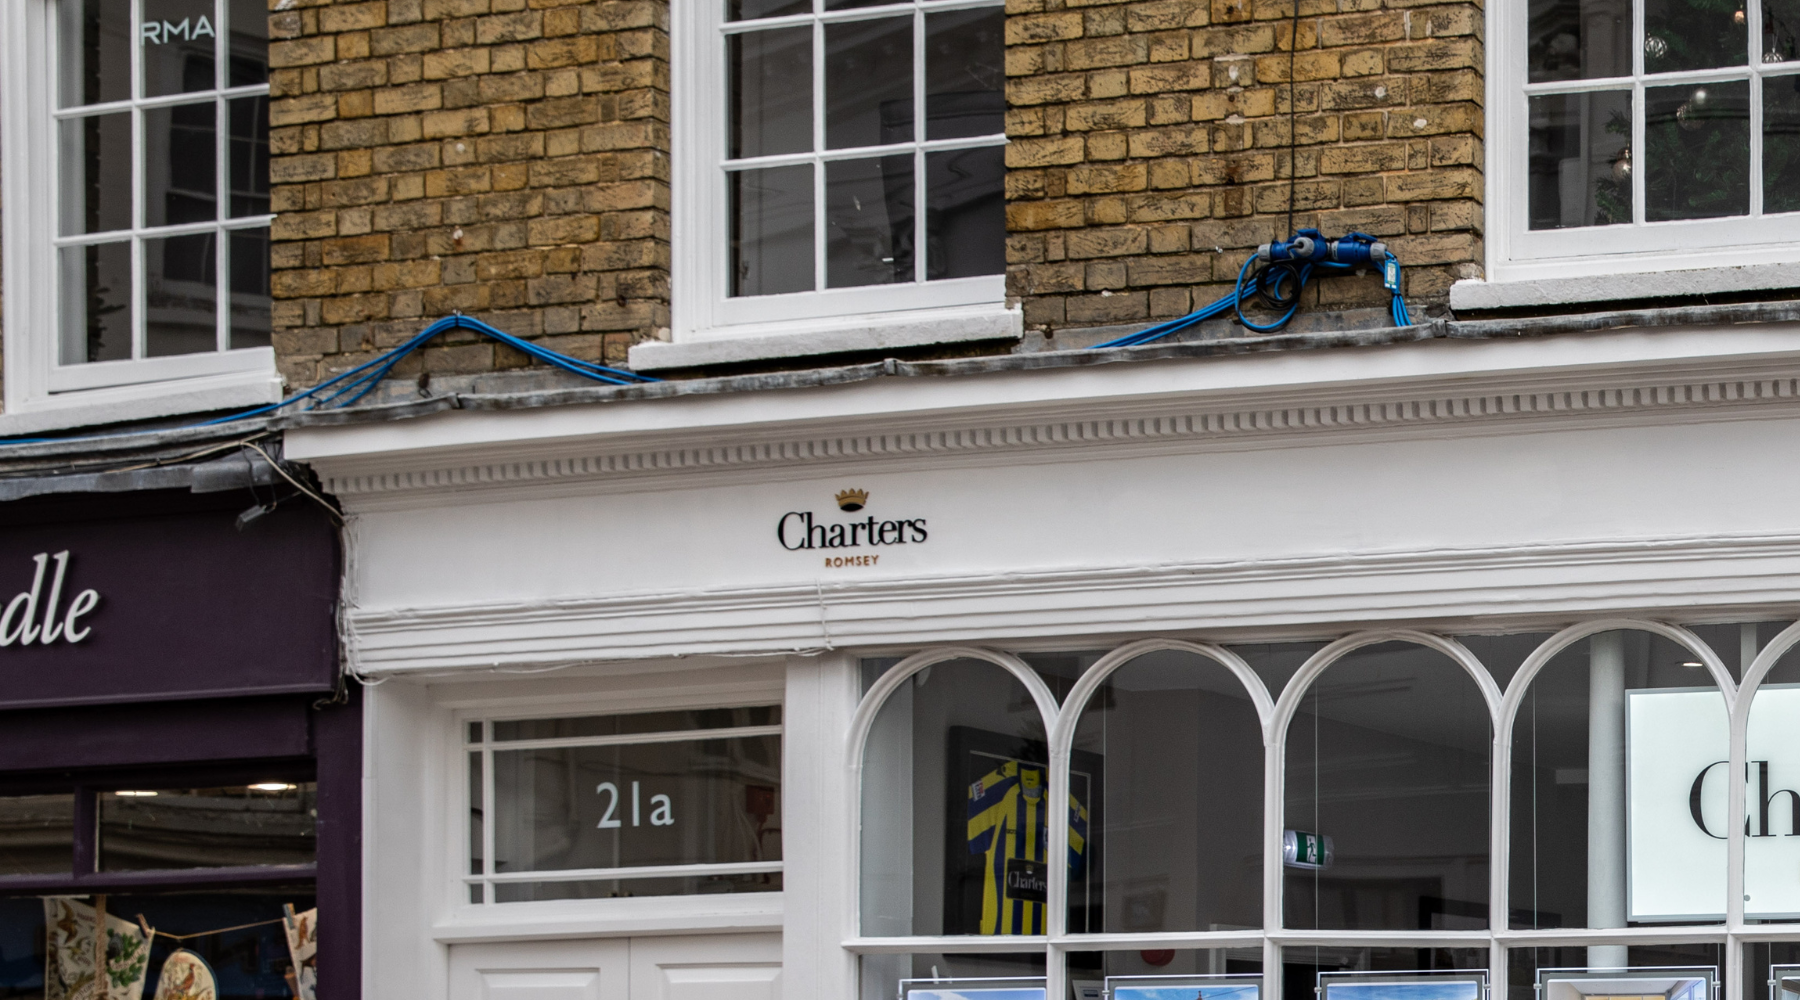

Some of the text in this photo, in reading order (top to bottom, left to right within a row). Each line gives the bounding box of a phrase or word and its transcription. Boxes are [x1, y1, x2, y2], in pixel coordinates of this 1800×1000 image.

[140, 15, 215, 45] RMA
[777, 511, 927, 550] Charters
[823, 555, 878, 568] ROMSEY
[596, 781, 675, 829] 21a
[1008, 870, 1048, 891] Charters
